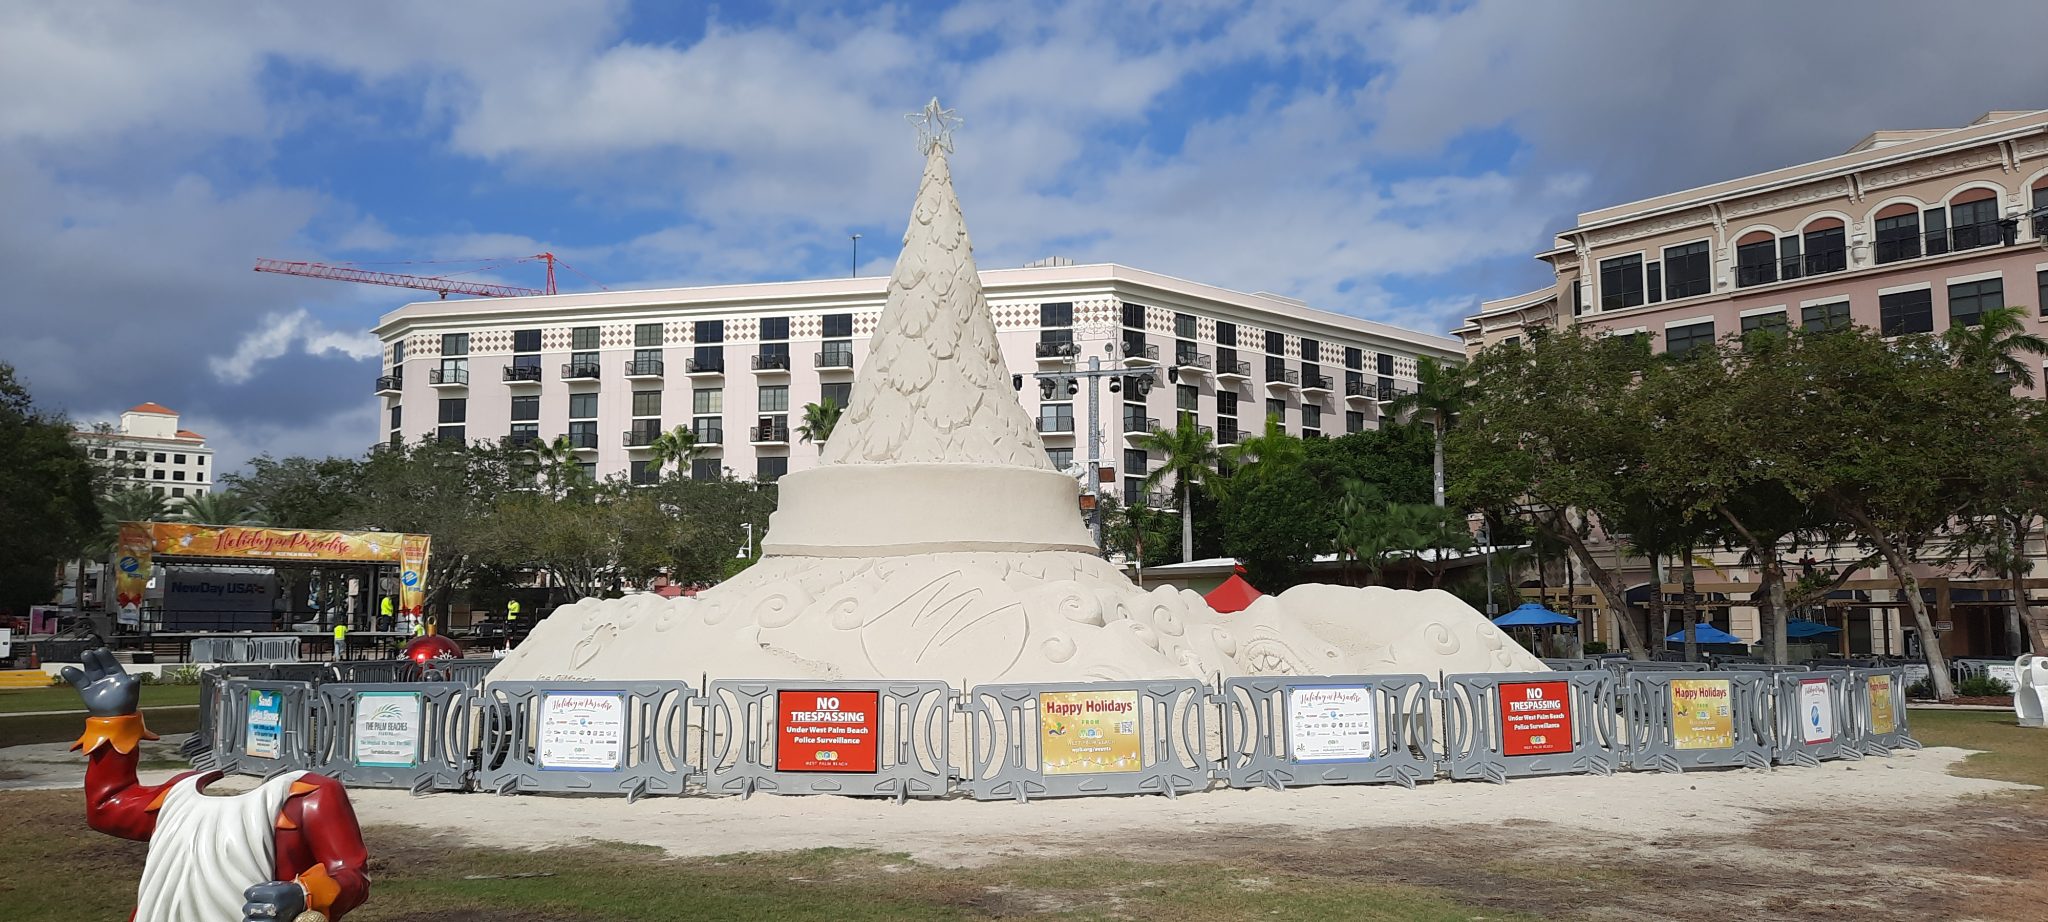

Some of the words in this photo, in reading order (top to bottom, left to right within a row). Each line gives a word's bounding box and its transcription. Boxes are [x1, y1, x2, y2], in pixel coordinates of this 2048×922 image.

[216, 529, 273, 552] Holiday
[288, 531, 351, 556] Paradise
[171, 582, 225, 596] NewDay
[226, 582, 254, 594] USA
[1301, 691, 1327, 704] Holiday
[1333, 691, 1361, 703] Paradise
[1526, 687, 1543, 699] NO
[1674, 687, 1697, 699] Happy
[1699, 686, 1727, 699] Holidays
[552, 696, 578, 710] Holiday
[584, 698, 613, 711] Paradise
[816, 697, 840, 710] NO
[1046, 701, 1083, 716] Happy
[1086, 699, 1133, 714] Holidays
[1509, 700, 1561, 711] TRESPASSING
[791, 711, 864, 722] TRESPASSING
[365, 722, 374, 731] THE
[374, 722, 387, 731] PALM
[387, 722, 408, 731] BEACHES
[1529, 722, 1560, 730] Surveillance
[816, 736, 861, 744] Surveillance
